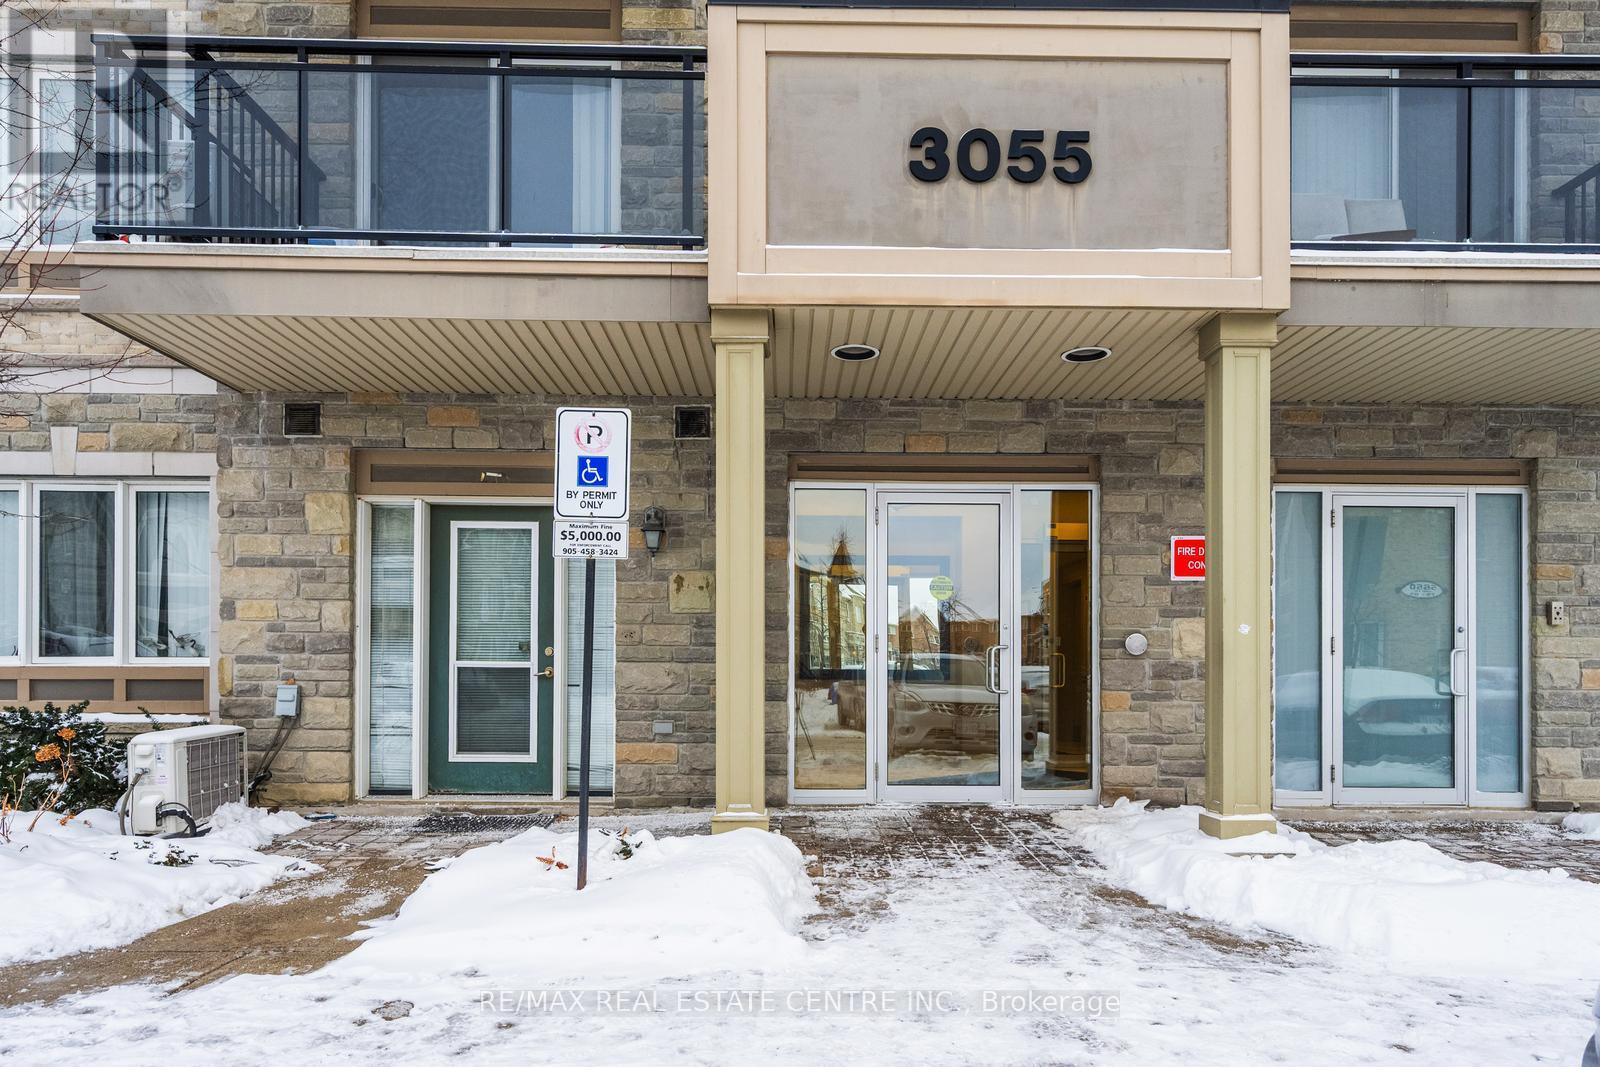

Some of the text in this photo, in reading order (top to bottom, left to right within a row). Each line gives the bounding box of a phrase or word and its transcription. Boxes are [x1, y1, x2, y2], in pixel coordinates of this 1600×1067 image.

[909, 127, 1092, 184] 3055
[566, 490, 617, 500] BY PERMIT
[579, 500, 604, 509] ONLY
[560, 530, 622, 542] $5,000.00
[1177, 546, 1196, 556] FIRE
